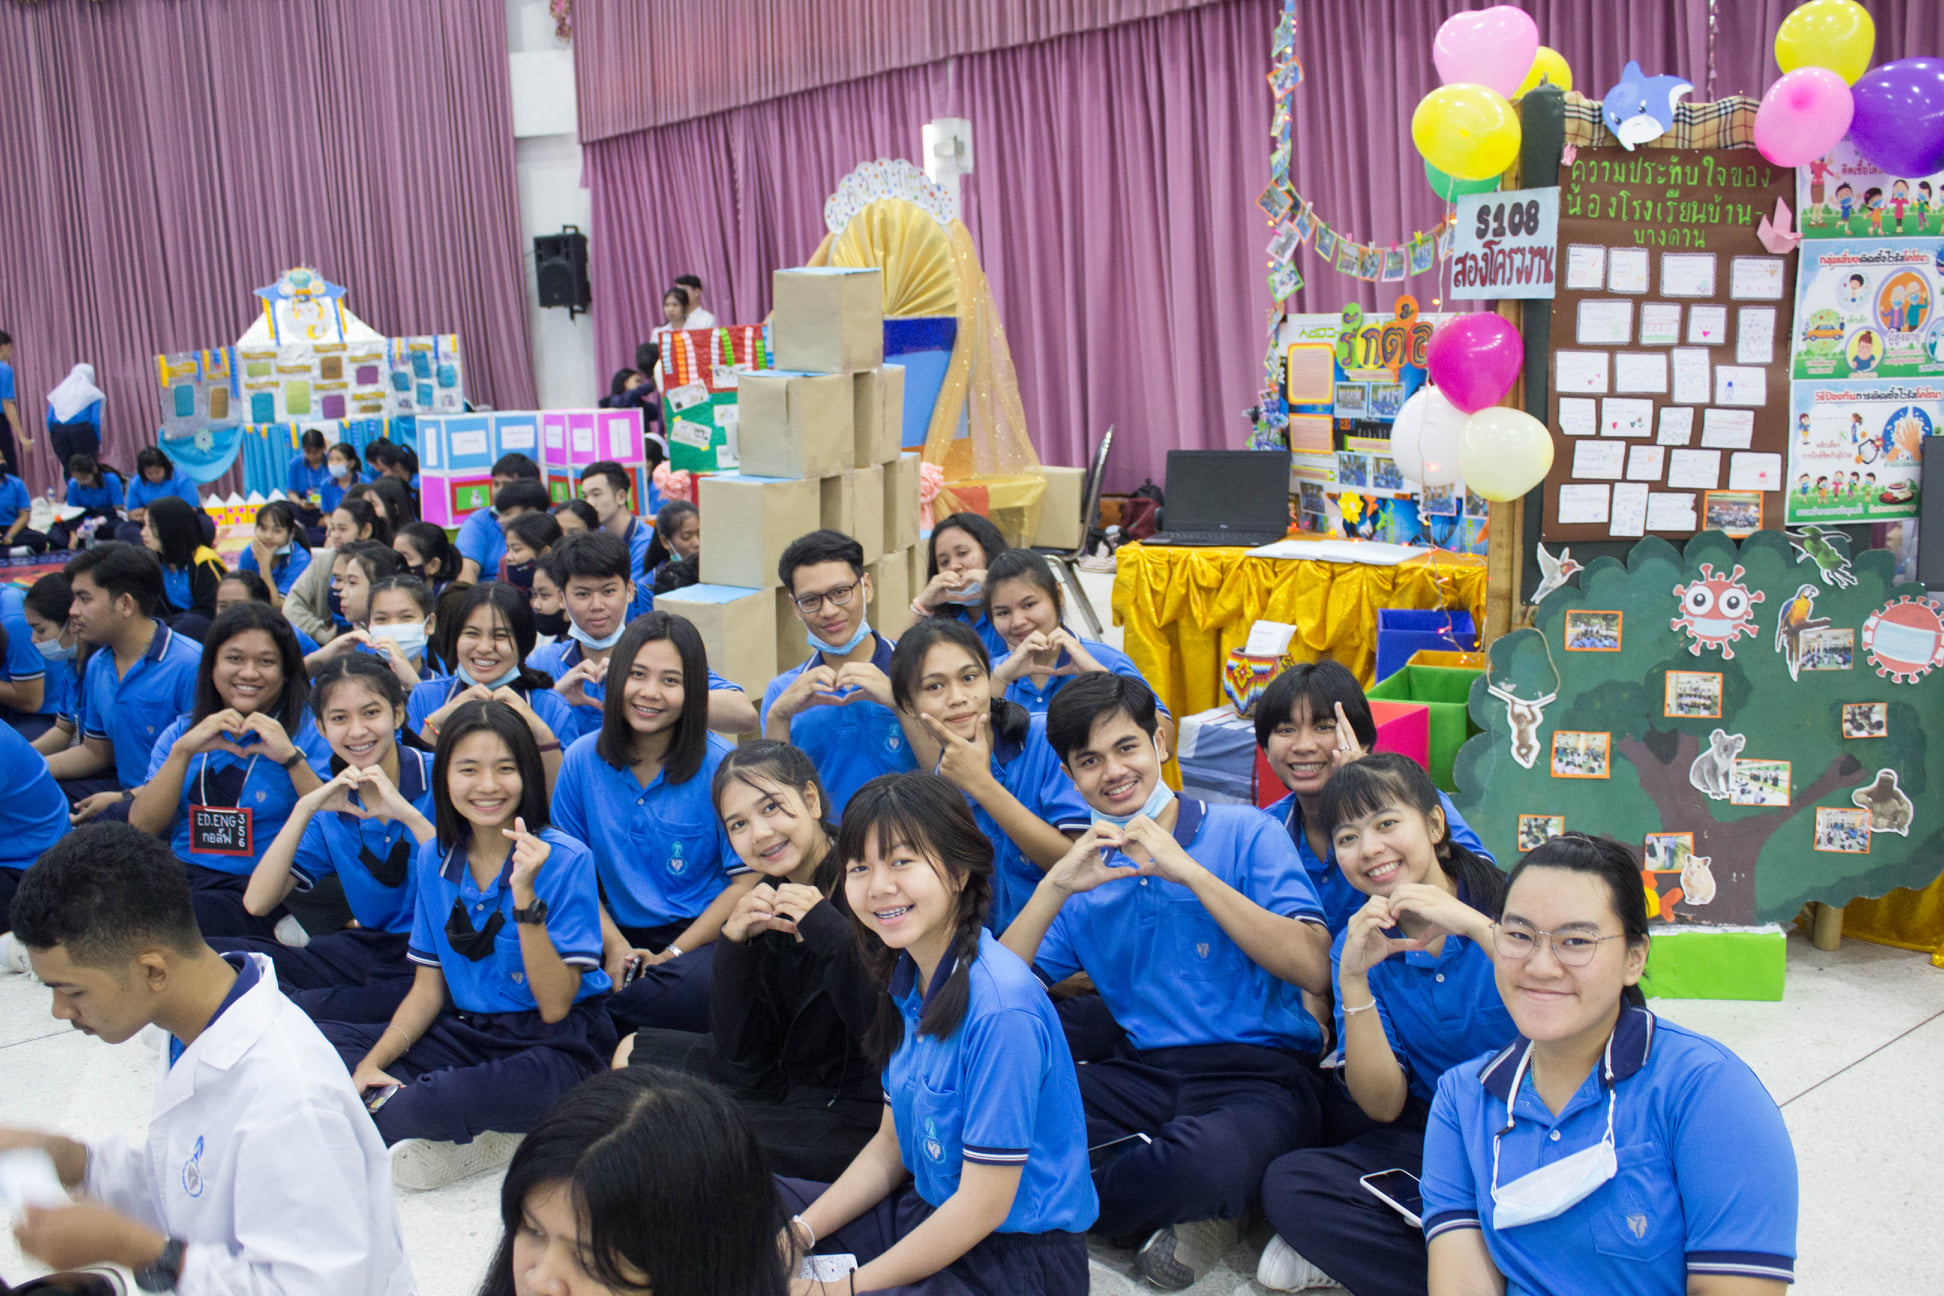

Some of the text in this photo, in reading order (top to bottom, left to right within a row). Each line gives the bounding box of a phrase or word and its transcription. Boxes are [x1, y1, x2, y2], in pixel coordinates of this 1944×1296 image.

[1571, 155, 1771, 187] ความประทับใจของ
[1475, 199, 1540, 240] S108
[197, 812, 237, 828] ED.ENG
[202, 827, 233, 845] กอล์ฟ
